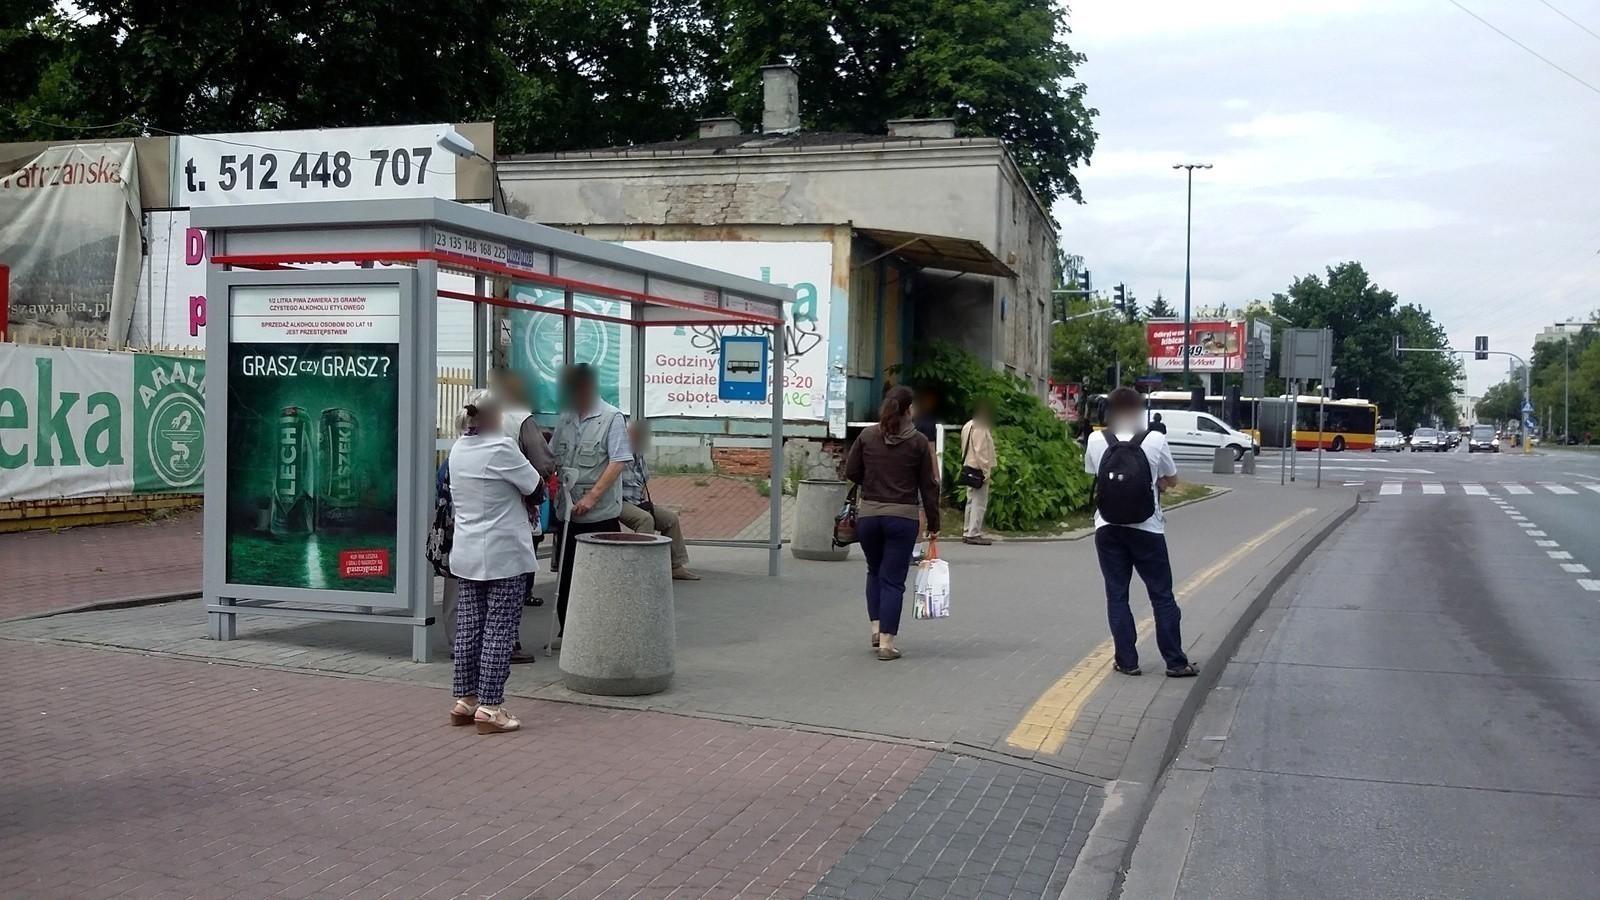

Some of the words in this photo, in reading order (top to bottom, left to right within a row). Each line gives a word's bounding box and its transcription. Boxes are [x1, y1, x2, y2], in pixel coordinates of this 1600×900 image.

[4, 156, 122, 188] atrzańska
[185, 157, 206, 192] t.
[218, 154, 278, 191] 512
[289, 151, 351, 188] 448
[369, 147, 432, 187] 707
[449, 236, 462, 250] 135
[464, 240, 477, 253] 148
[480, 243, 492, 256] 168
[494, 246, 506, 259] 225
[8, 292, 112, 318] szawianka.pl
[243, 355, 298, 376] GRASZ
[300, 360, 319, 375] czy
[656, 354, 717, 370] Godziny
[667, 390, 718, 403] sobota
[280, 427, 297, 496] LECH
